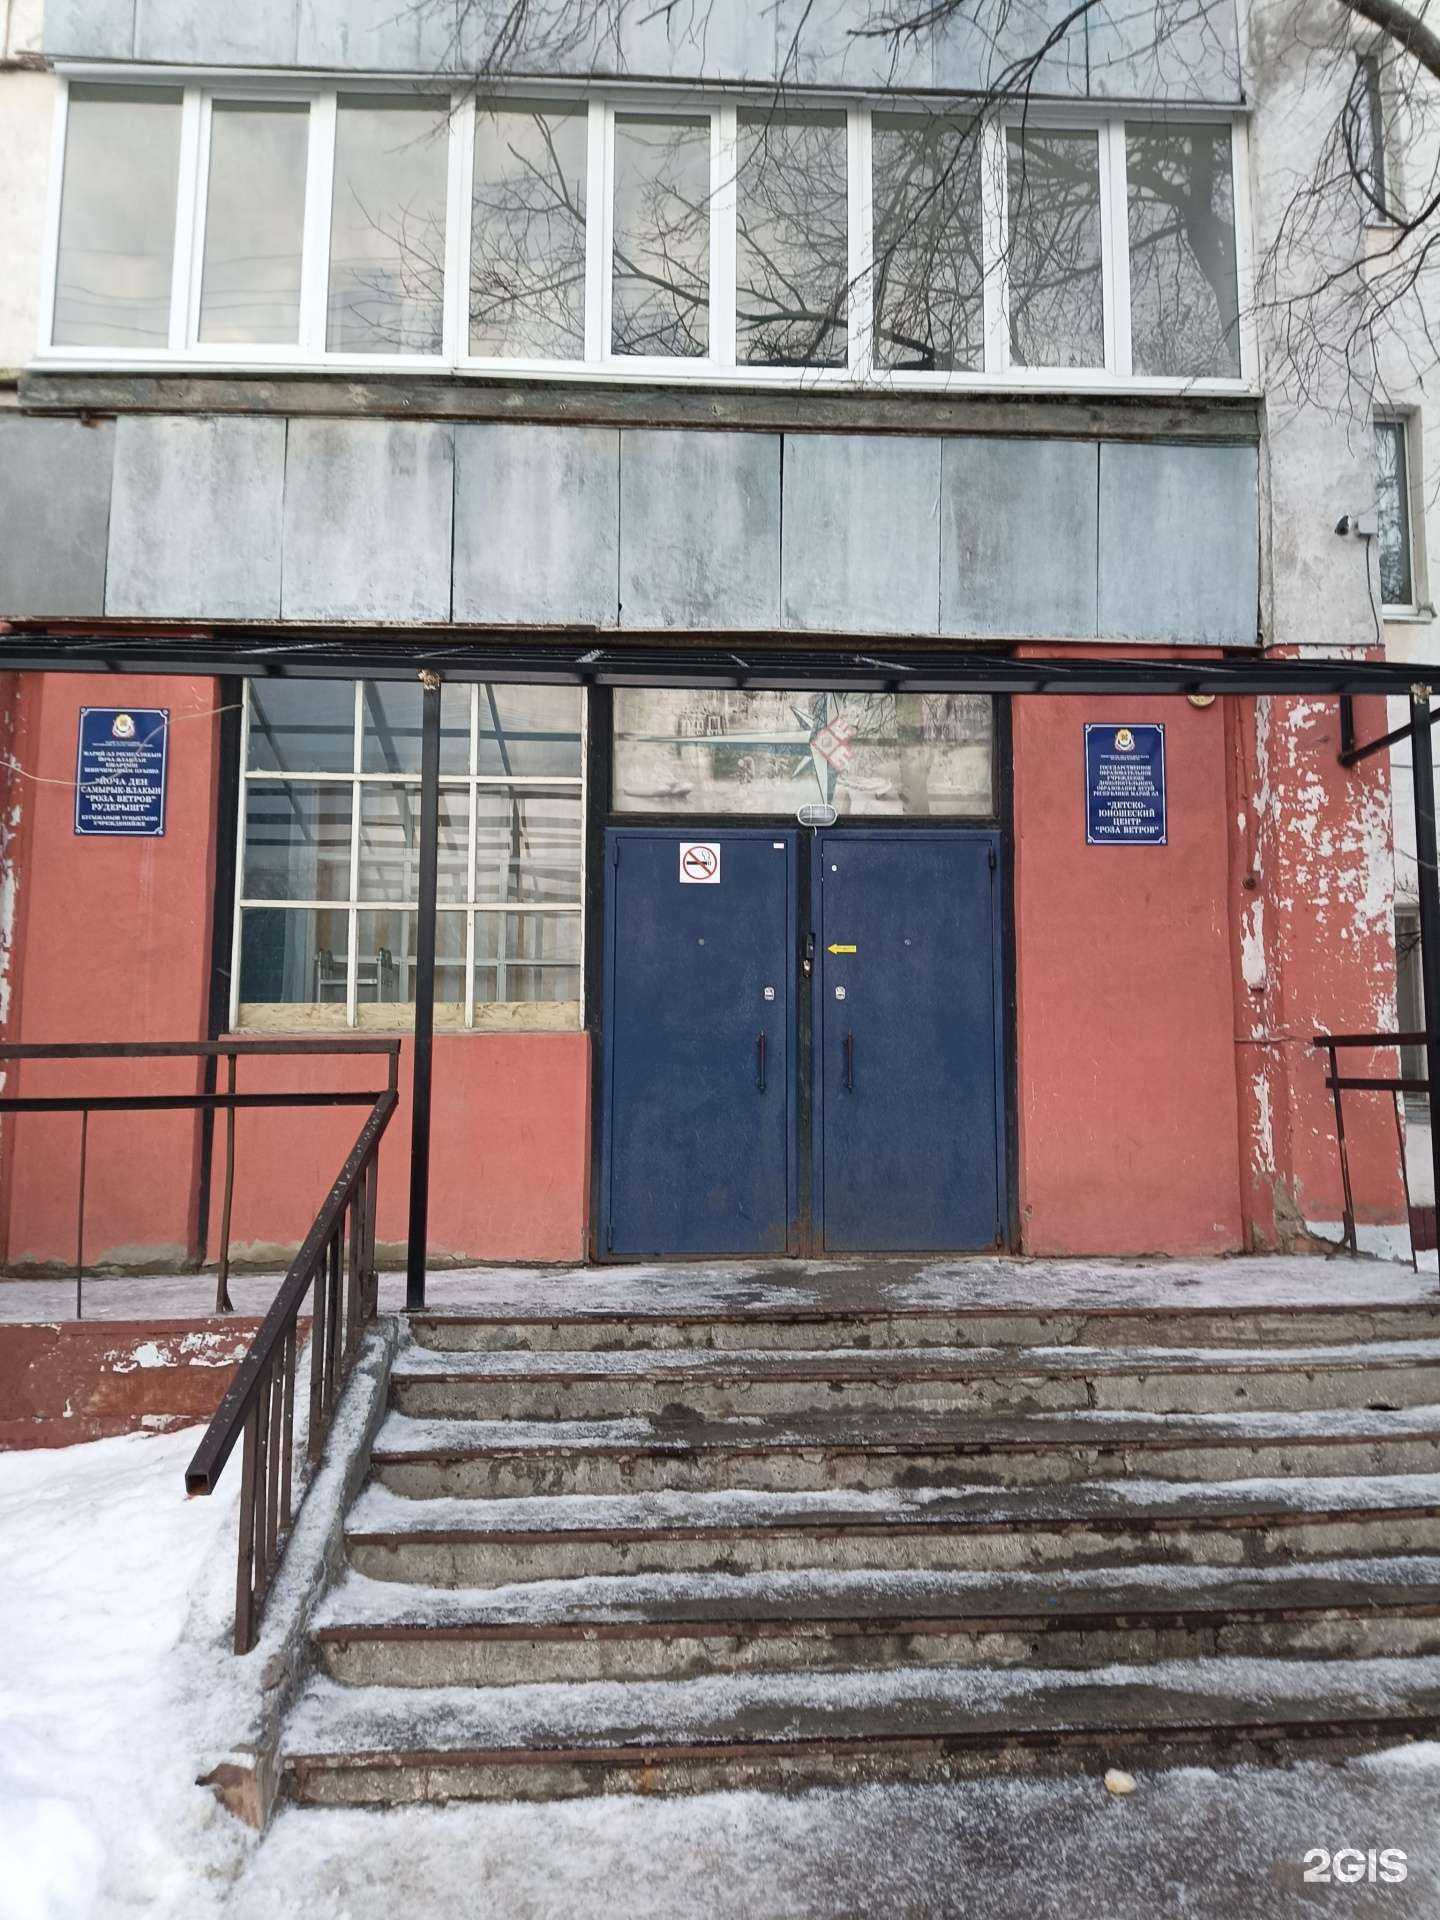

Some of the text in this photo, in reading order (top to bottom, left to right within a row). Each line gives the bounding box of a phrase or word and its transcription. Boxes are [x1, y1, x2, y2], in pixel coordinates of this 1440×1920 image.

[1098, 808, 1155, 818] ЮНОШЕСКИЙ
[1113, 817, 1141, 826] ЦЕНТР
[1095, 826, 1159, 834] "РОЗА ВЕТРОВ"
